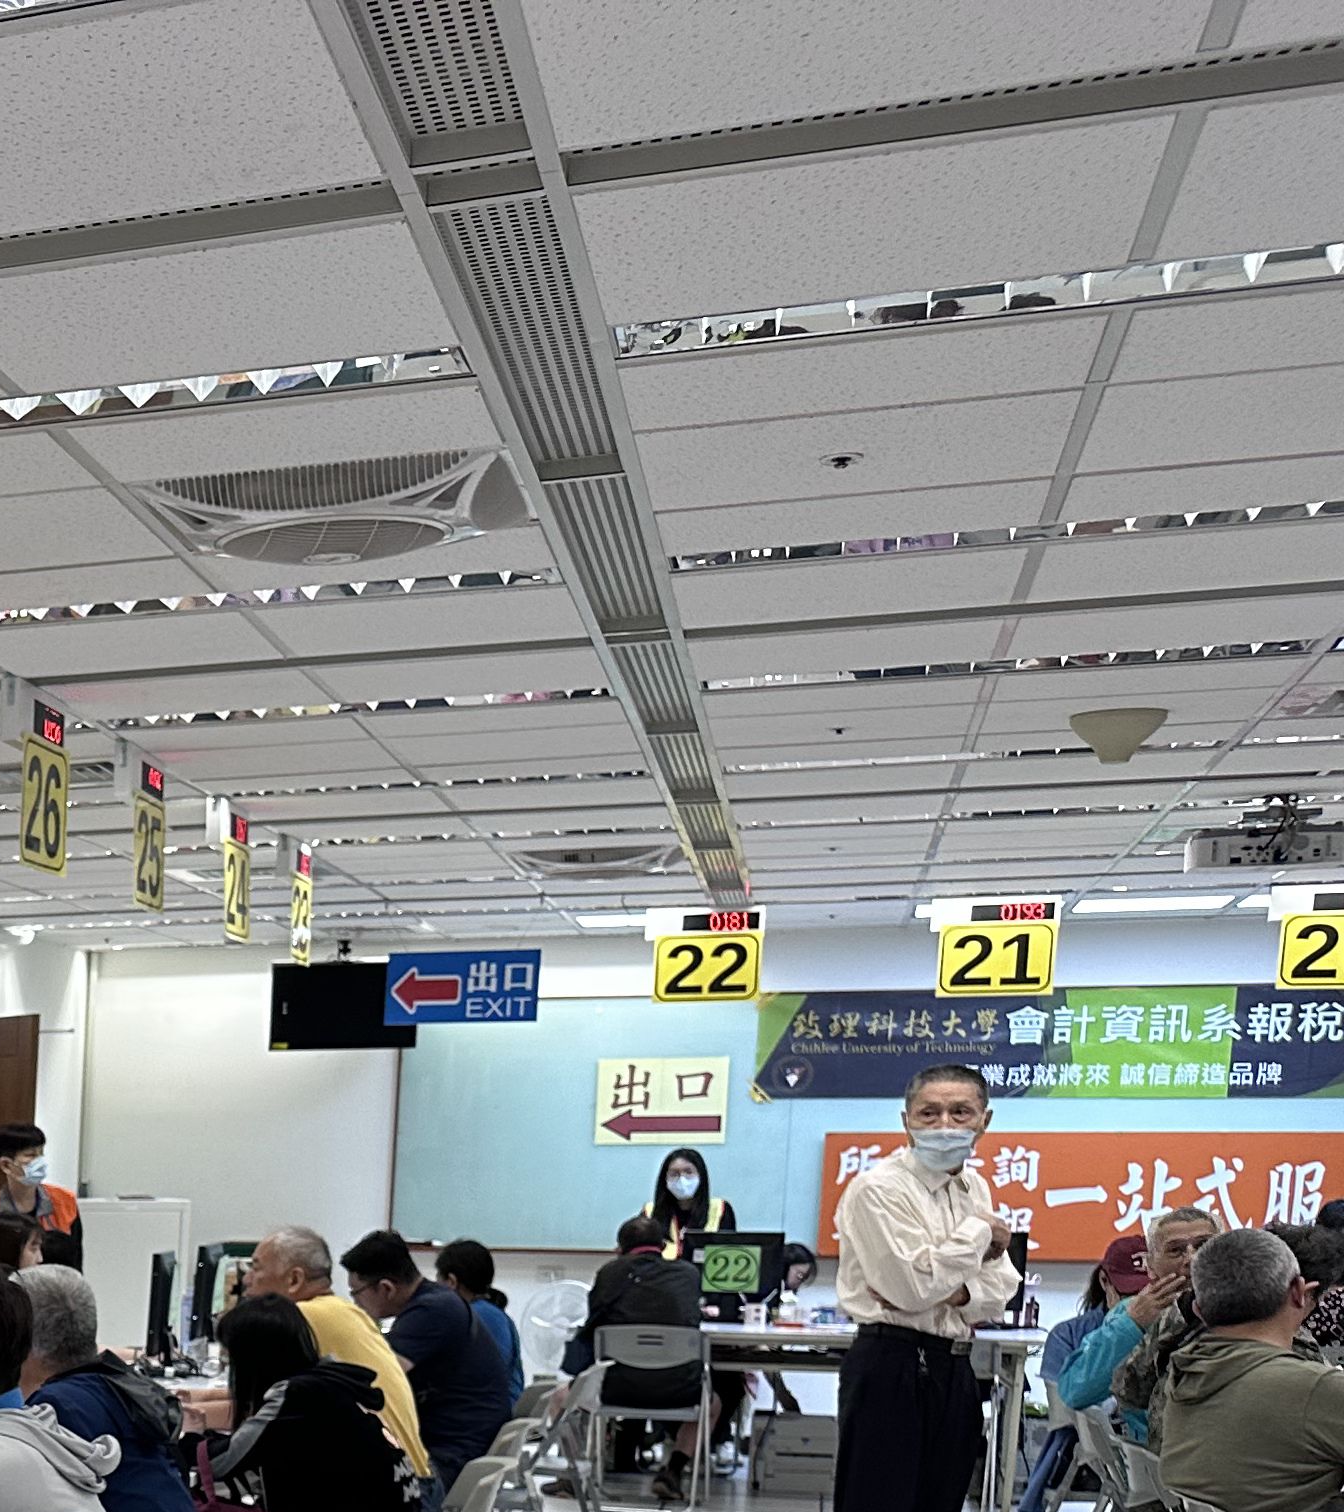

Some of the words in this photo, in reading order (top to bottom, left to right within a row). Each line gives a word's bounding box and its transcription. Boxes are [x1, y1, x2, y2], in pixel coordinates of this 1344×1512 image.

[25, 755, 61, 859] 26
[137, 810, 161, 898] 25
[226, 854, 247, 930] 24
[1000, 902, 1047, 922] 0193
[709, 911, 750, 932] 0181
[466, 960, 536, 994] 出口
[664, 941, 749, 996] 22
[949, 931, 1044, 987] 21
[465, 996, 532, 1019] EXIT
[842, 1041, 903, 1057] University
[923, 1039, 997, 1058] Technology
[610, 1064, 714, 1110] 出口
[966, 1062, 1111, 1088] 業成就將來
[1120, 1061, 1284, 1087] 誠信締造品牌
[836, 1145, 1042, 1191] 所詢
[711, 1253, 752, 1283] 22
